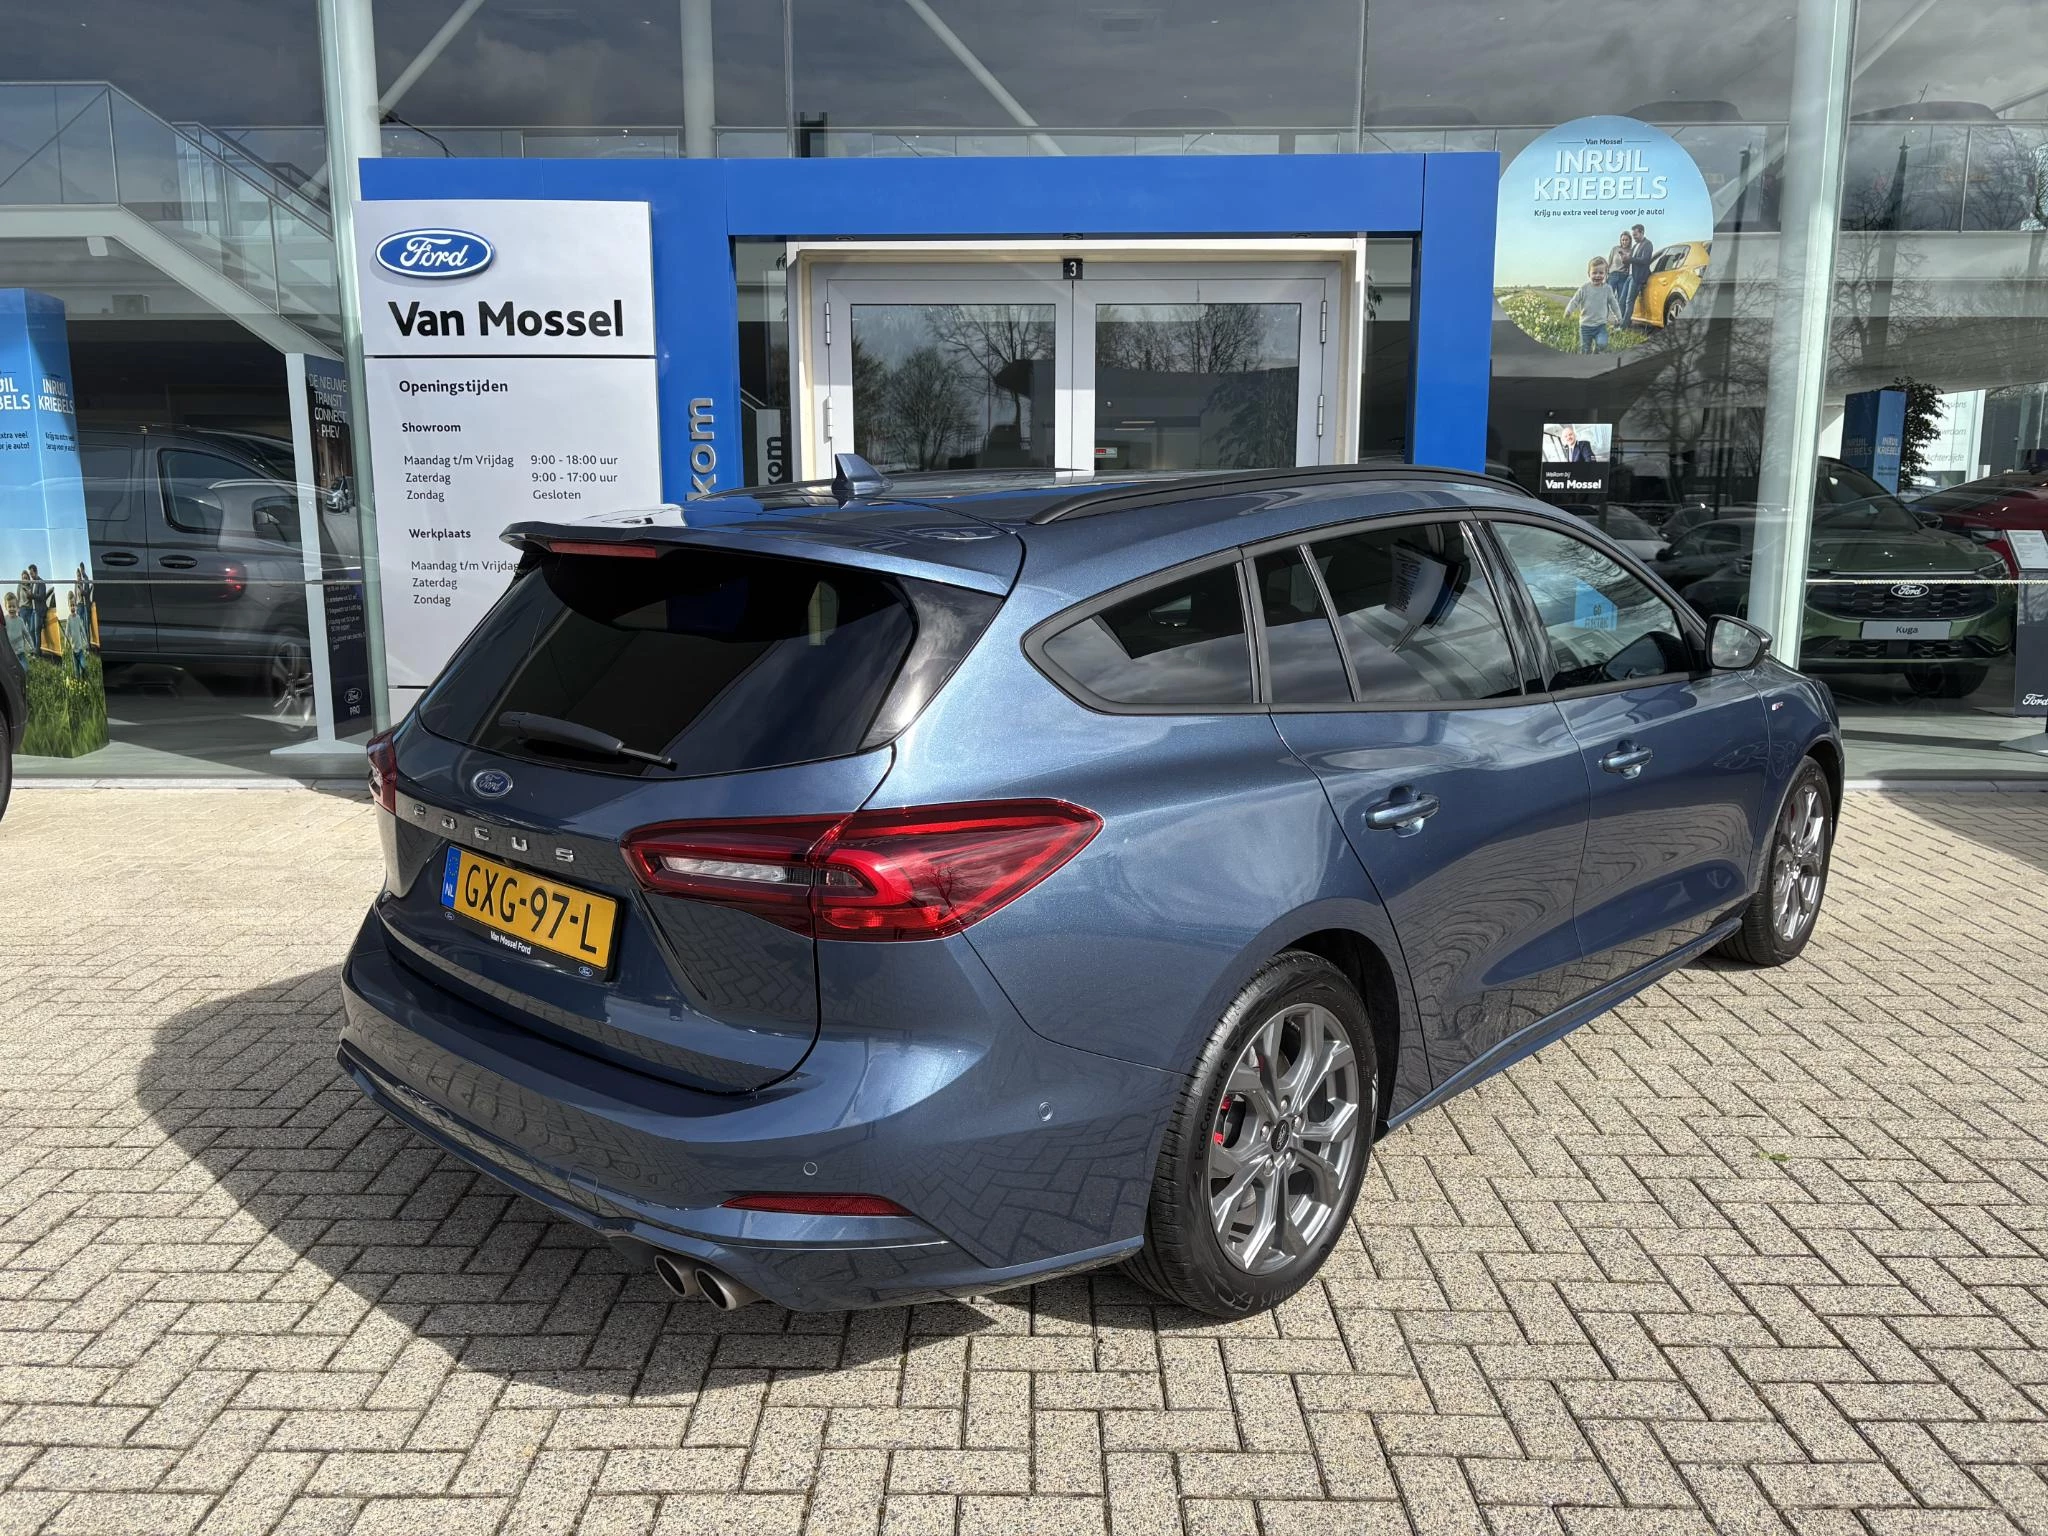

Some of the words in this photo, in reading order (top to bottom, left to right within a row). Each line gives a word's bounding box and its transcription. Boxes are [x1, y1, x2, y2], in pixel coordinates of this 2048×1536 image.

[1554, 150, 1649, 173] INRUIL
[1533, 176, 1668, 201] KRIEBELS
[1534, 209, 1551, 217] Krijg
[1600, 209, 1619, 217] terug
[1637, 208, 1644, 216] je
[399, 237, 468, 267] Ford
[1070, 261, 1077, 277] 3
[388, 301, 464, 336] Van
[478, 299, 624, 337] Mossel
[42, 378, 68, 397] INRUIL
[399, 379, 508, 396] Openingstijden
[37, 394, 74, 414] KRIEBELS
[314, 391, 343, 407] TRANSIT
[314, 407, 347, 423] CONNECT
[321, 424, 340, 438] PHEV
[401, 422, 461, 433] Showroom
[404, 455, 451, 467] Maandag
[453, 455, 473, 465] t/m
[475, 455, 514, 467] Vrijdag
[530, 455, 555, 465] 9:00
[566, 455, 597, 465] 18:00
[600, 456, 618, 465] uur
[405, 472, 451, 484] Zaterdag
[531, 472, 556, 482] 9:00
[568, 472, 597, 482] 17:00
[600, 473, 618, 482] uur
[1545, 479, 1564, 489] Van
[1566, 479, 1602, 489] Mossel
[406, 490, 444, 502] Zondag
[532, 489, 581, 500] Gesloten
[408, 528, 471, 541] Werkplaats
[411, 561, 457, 573] Maandag
[459, 561, 479, 571] t/m
[482, 561, 520, 573] Vrijdag
[412, 577, 457, 589] Zaterdag
[1898, 584, 1922, 595] Ford
[413, 594, 451, 606] Zondag
[1895, 626, 1919, 634] Kuga
[444, 883, 455, 898] NL
[464, 864, 598, 955] GXG-97-L
[490, 930, 500, 942] Van
[500, 935, 518, 949] Mossel
[518, 942, 532, 955] Ford
